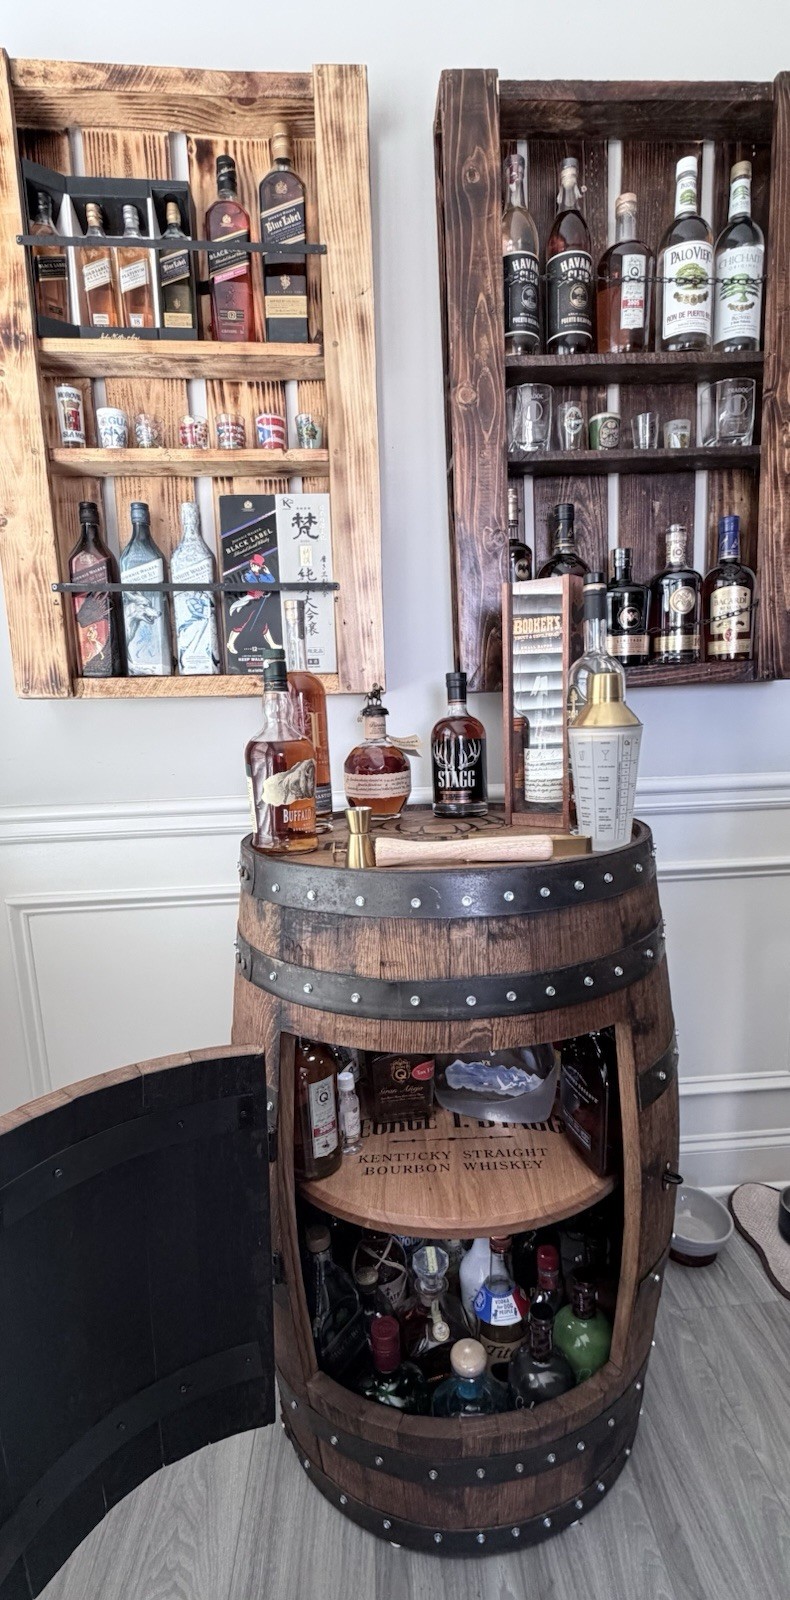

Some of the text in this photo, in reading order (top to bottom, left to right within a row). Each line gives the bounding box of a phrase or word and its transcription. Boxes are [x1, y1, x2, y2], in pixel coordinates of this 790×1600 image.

[265, 211, 302, 234] Blue Label
[630, 266, 639, 277] Q
[667, 313, 678, 323] RON
[225, 528, 274, 555] BLACK LABEL
[513, 615, 561, 635] BOOKER'S
[437, 770, 476, 788] STAGG
[283, 808, 312, 823] BUFFALO
[394, 1068, 407, 1080] Q
[319, 1091, 329, 1103] Q
[358, 1147, 549, 1164] KENTUCKY STRAIGHT
[363, 1159, 544, 1176] BOURBON WHISKEY
